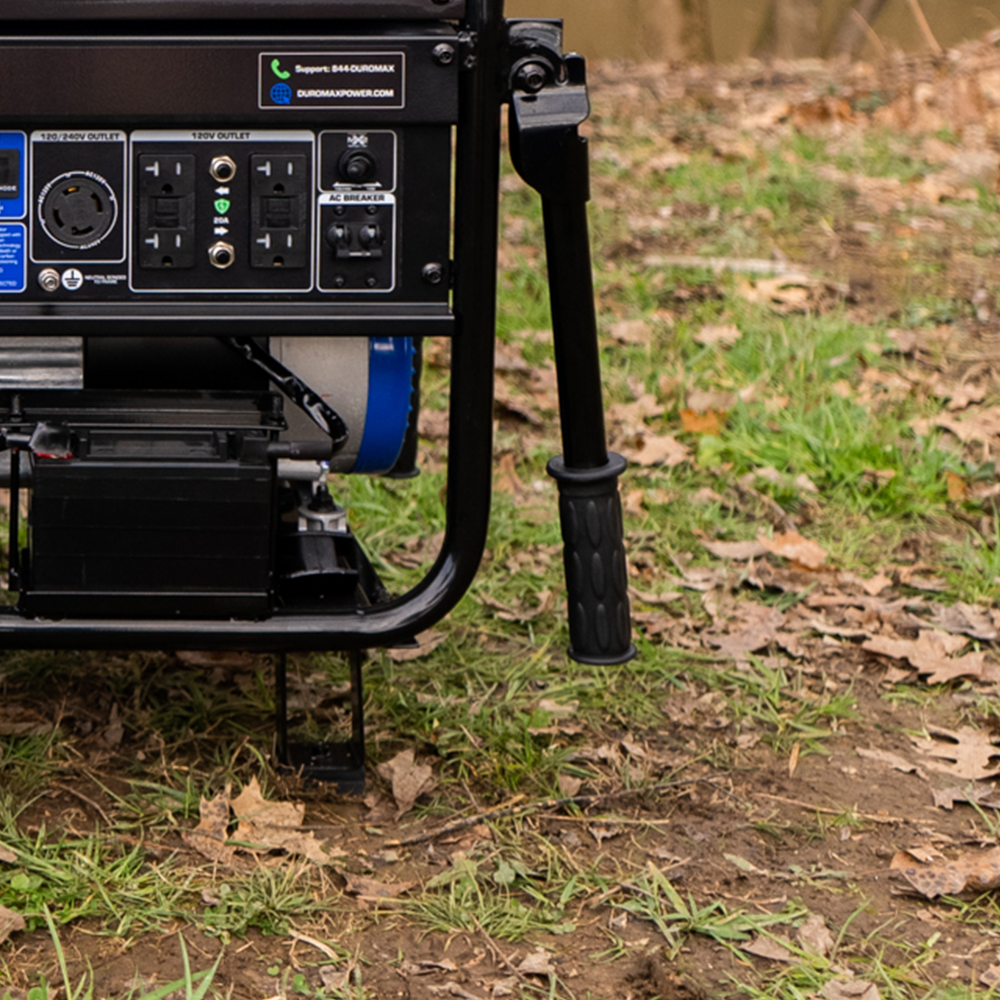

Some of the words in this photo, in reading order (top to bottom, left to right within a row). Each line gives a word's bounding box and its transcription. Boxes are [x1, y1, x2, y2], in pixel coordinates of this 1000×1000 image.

[294, 64, 331, 74] Support:
[331, 64, 395, 73] 844-DUROMAX
[296, 89, 395, 98] DUROMAXPOWER.COM
[40, 132, 86, 141] 120/240V
[87, 132, 120, 141] OUTLET
[191, 132, 216, 140] 120V
[216, 132, 251, 140] OUTLET
[329, 194, 342, 202] AC
[343, 194, 386, 202] BREAKER
[213, 216, 230, 225] 20A
